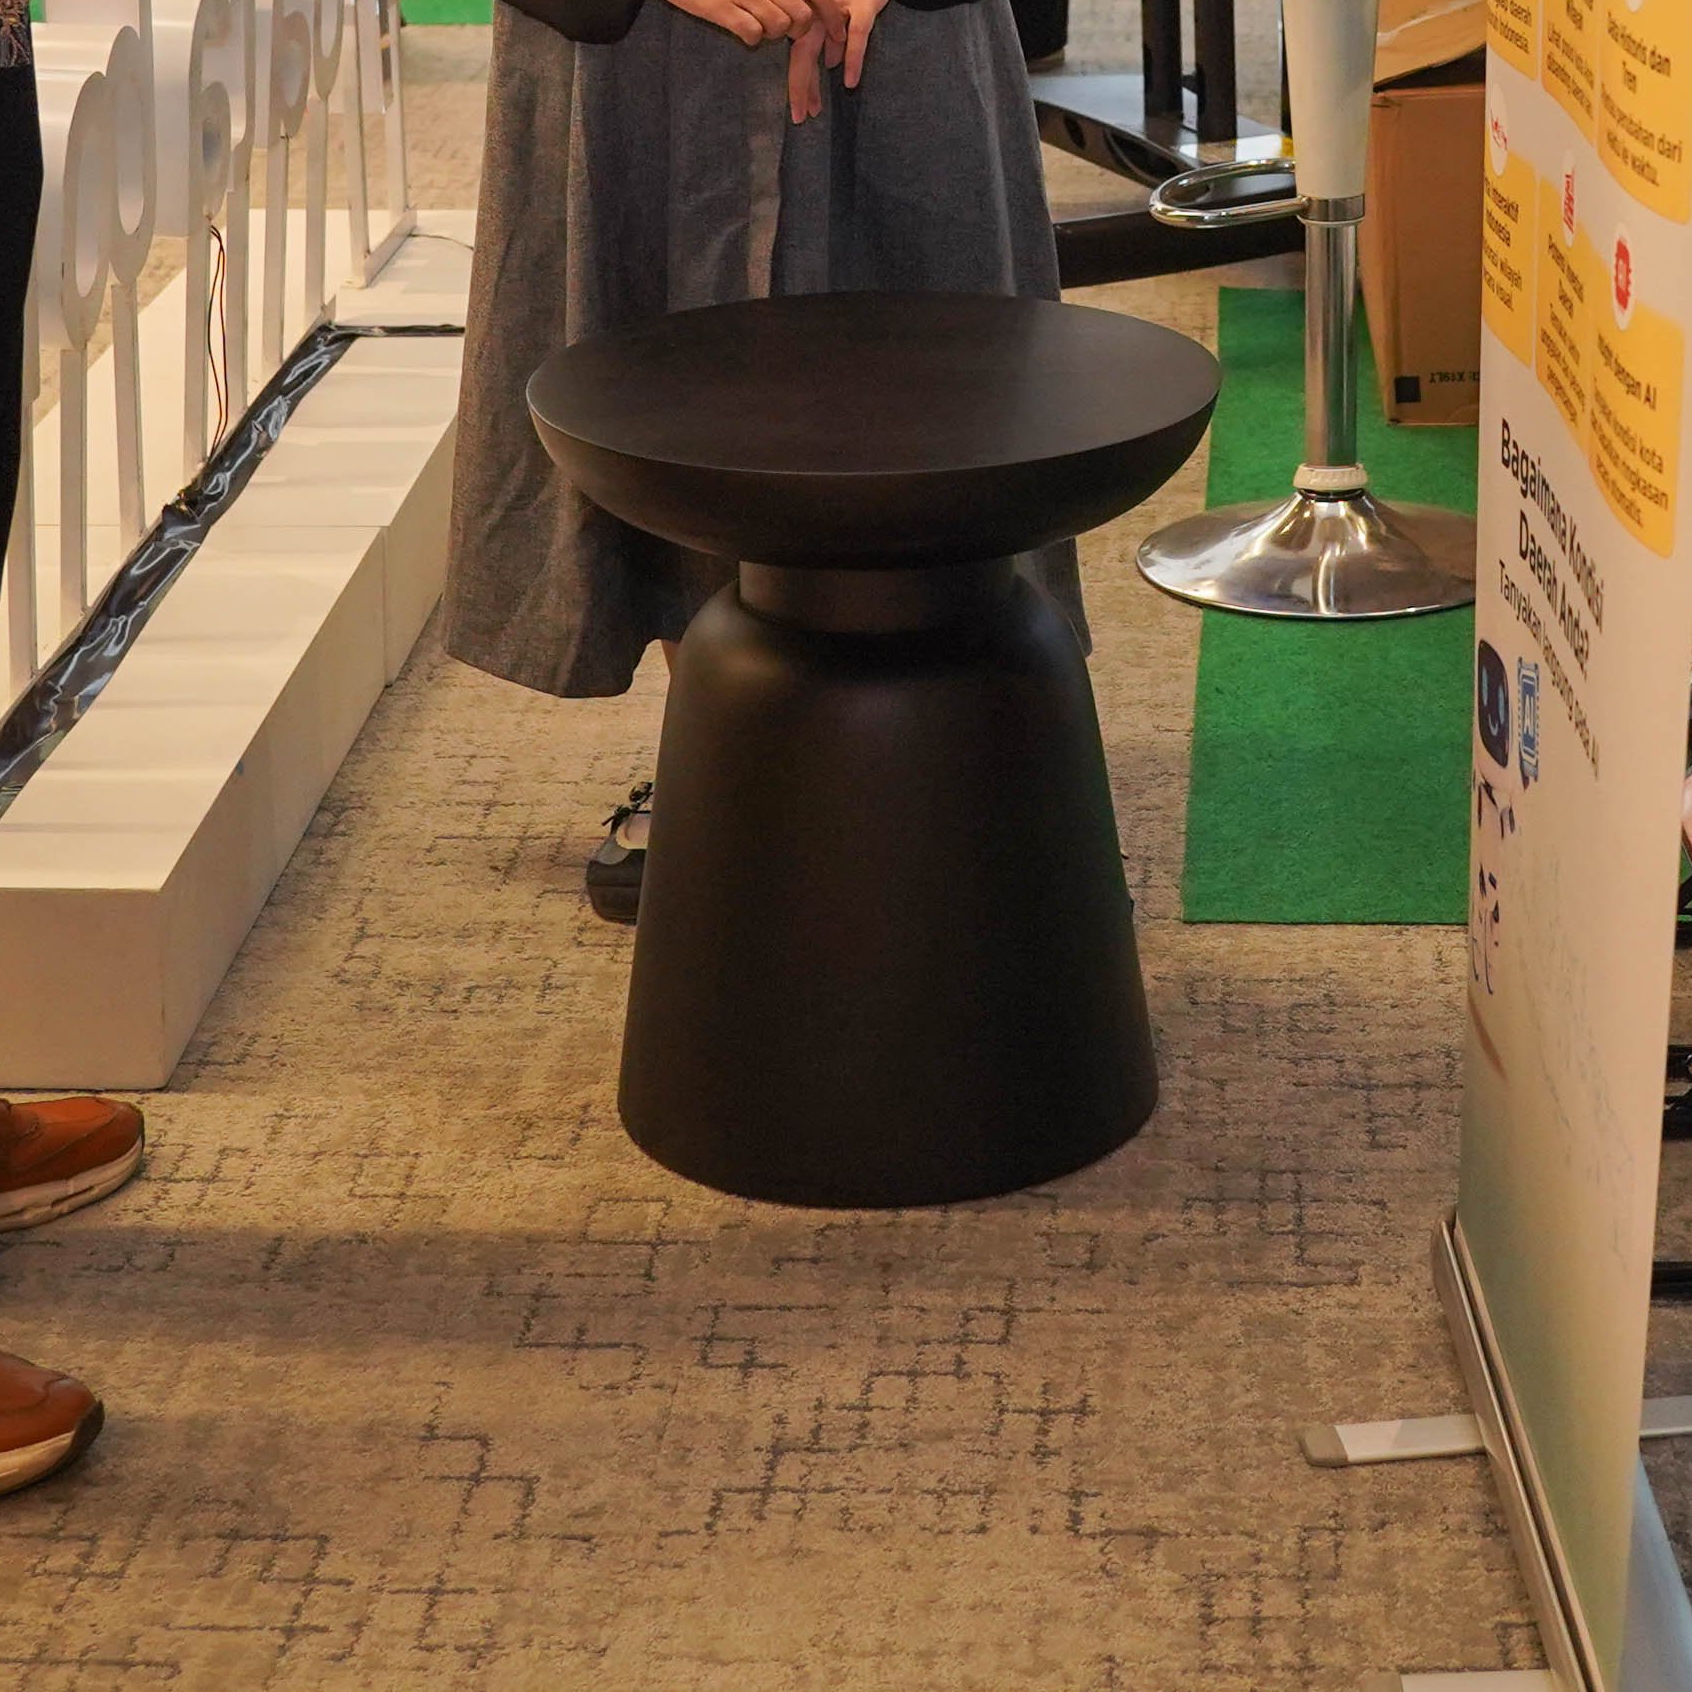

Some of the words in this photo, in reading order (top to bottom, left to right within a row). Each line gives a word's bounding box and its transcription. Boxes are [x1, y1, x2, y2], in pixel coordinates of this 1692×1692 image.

[1649, 45, 1671, 77] dan
[1657, 134, 1683, 164] dari
[1639, 436, 1664, 475] kota
[1501, 417, 1567, 556] Bagaimana
[1569, 516, 1604, 634] Kondisi
[1499, 558, 1542, 647] Tanyakan
[1519, 509, 1558, 616] Daerah
[1559, 581, 1590, 682] Anda?
